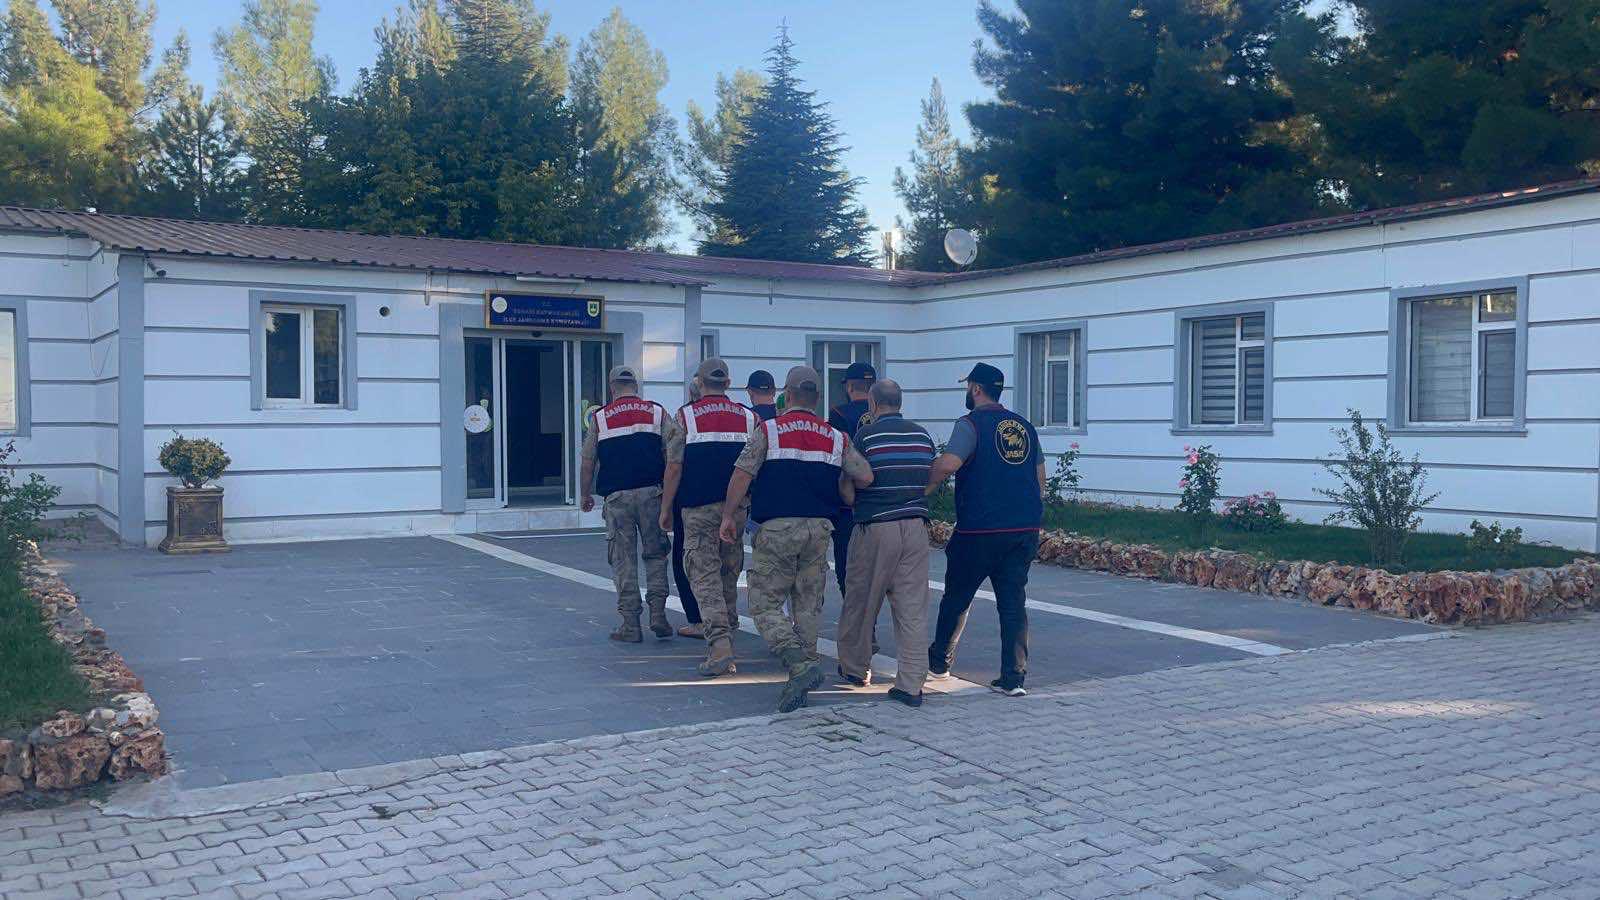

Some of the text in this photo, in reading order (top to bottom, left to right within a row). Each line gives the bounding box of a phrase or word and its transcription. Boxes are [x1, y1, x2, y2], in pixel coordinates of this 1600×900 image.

[517, 317, 550, 325] JANMA
[551, 318, 588, 326] KOMUTANL
[605, 403, 654, 418] JANDARMA
[694, 402, 746, 417] JANDARMA
[777, 420, 834, 440] JANDARMA
